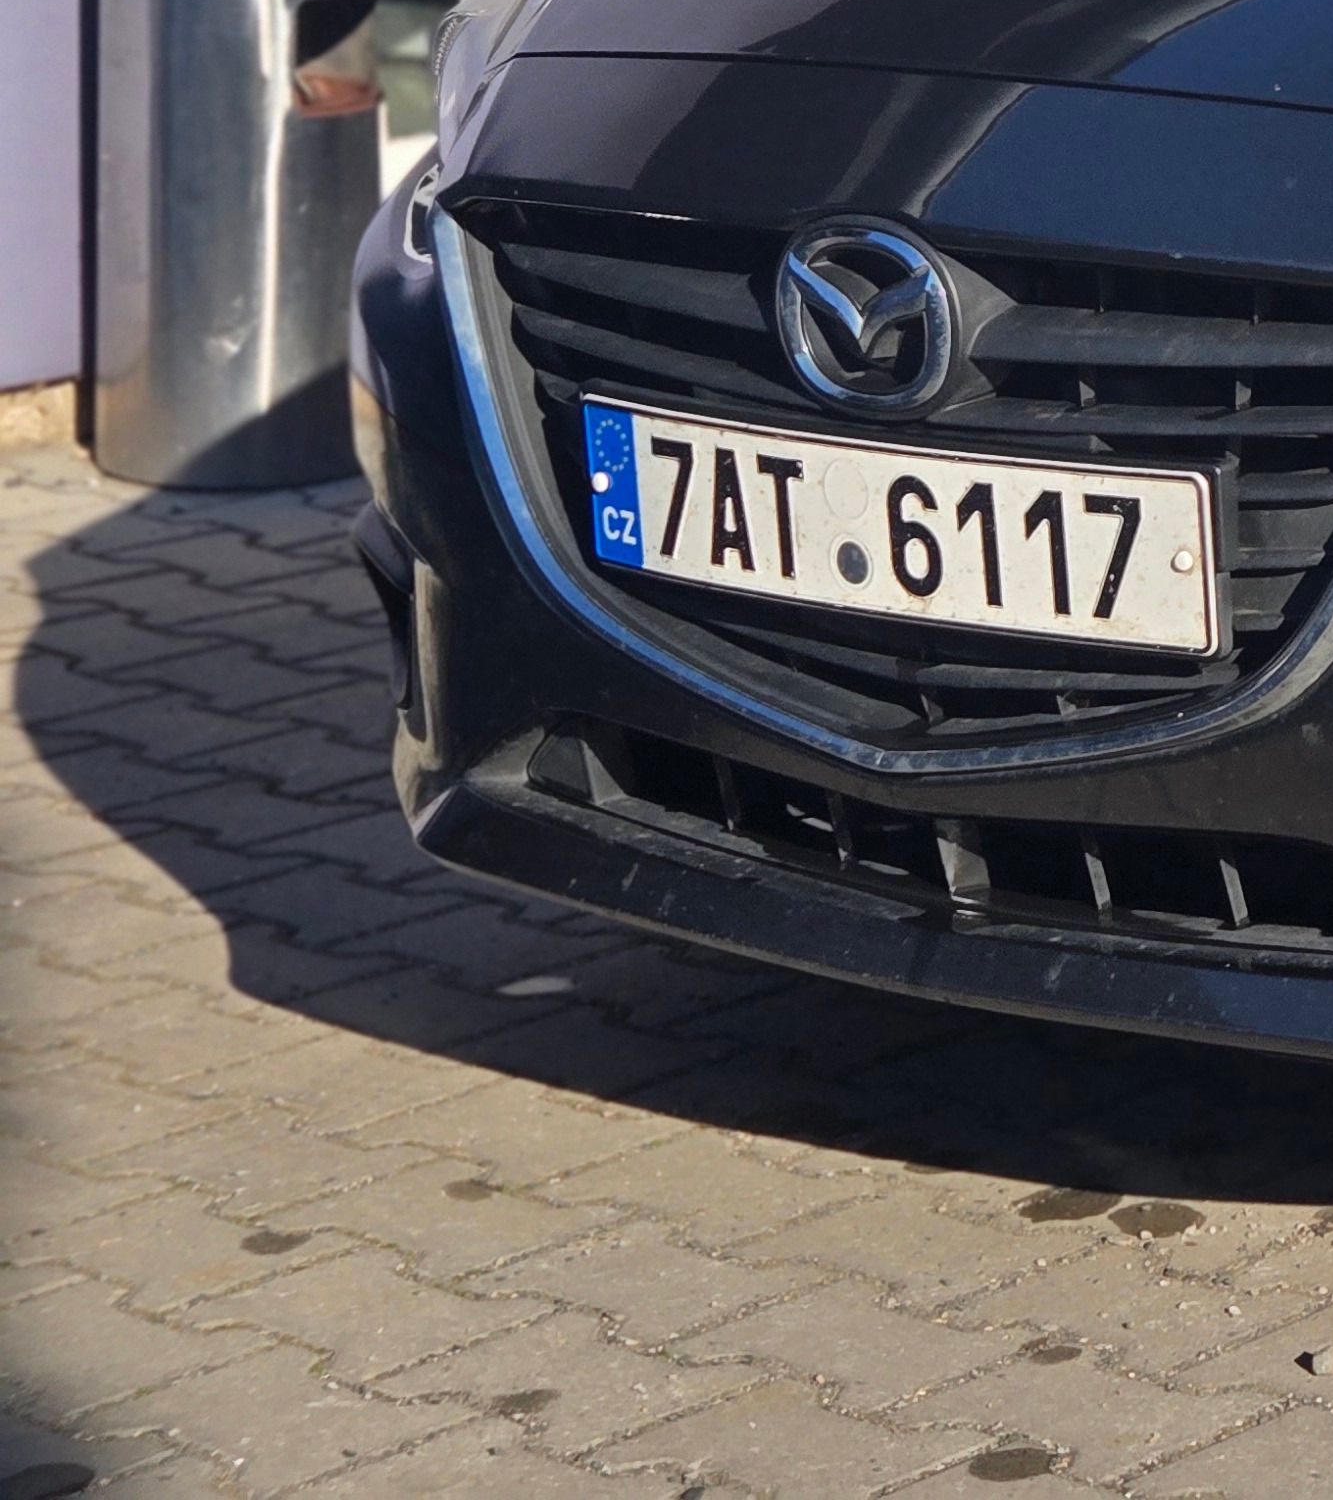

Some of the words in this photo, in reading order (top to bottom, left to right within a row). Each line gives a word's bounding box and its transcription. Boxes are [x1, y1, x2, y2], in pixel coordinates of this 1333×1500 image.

[602, 505, 638, 547] CZ
[650, 434, 805, 580] 7AT
[885, 473, 1143, 620] 6117
